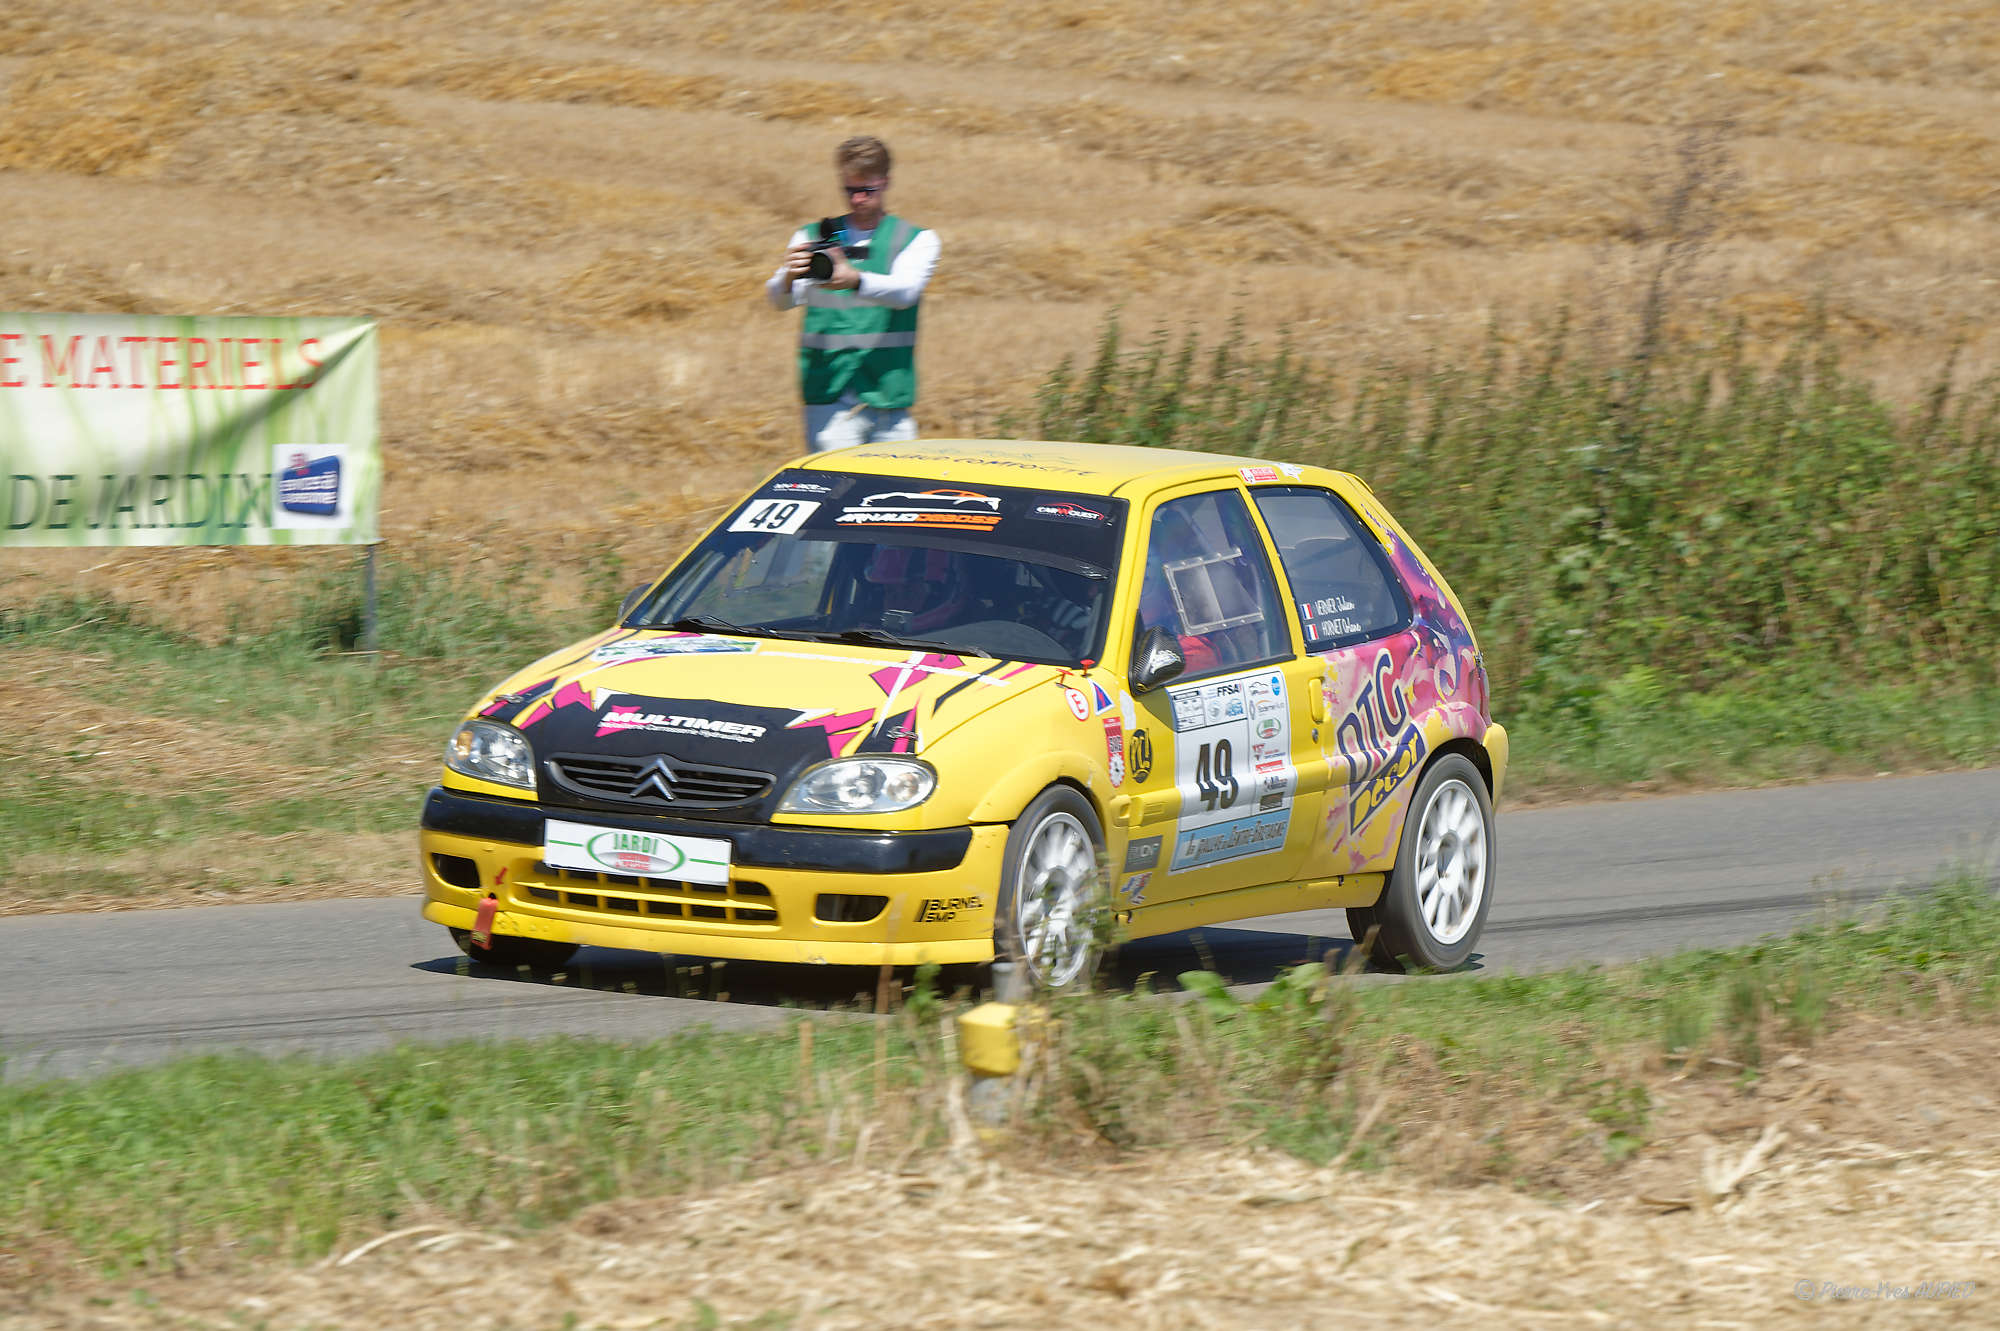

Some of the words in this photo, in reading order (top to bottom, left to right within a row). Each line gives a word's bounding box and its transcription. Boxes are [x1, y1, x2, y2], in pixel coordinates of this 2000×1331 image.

[0, 334, 24, 387] E
[40, 334, 322, 390] MATERIELS
[8, 474, 75, 529] DE
[749, 503, 799, 529] 49
[1071, 693, 1085, 713] E
[1217, 683, 1239, 697] FFSA
[601, 711, 768, 738] MULTIMER
[1196, 738, 1239, 811] 49
[614, 833, 659, 856] JARDI
